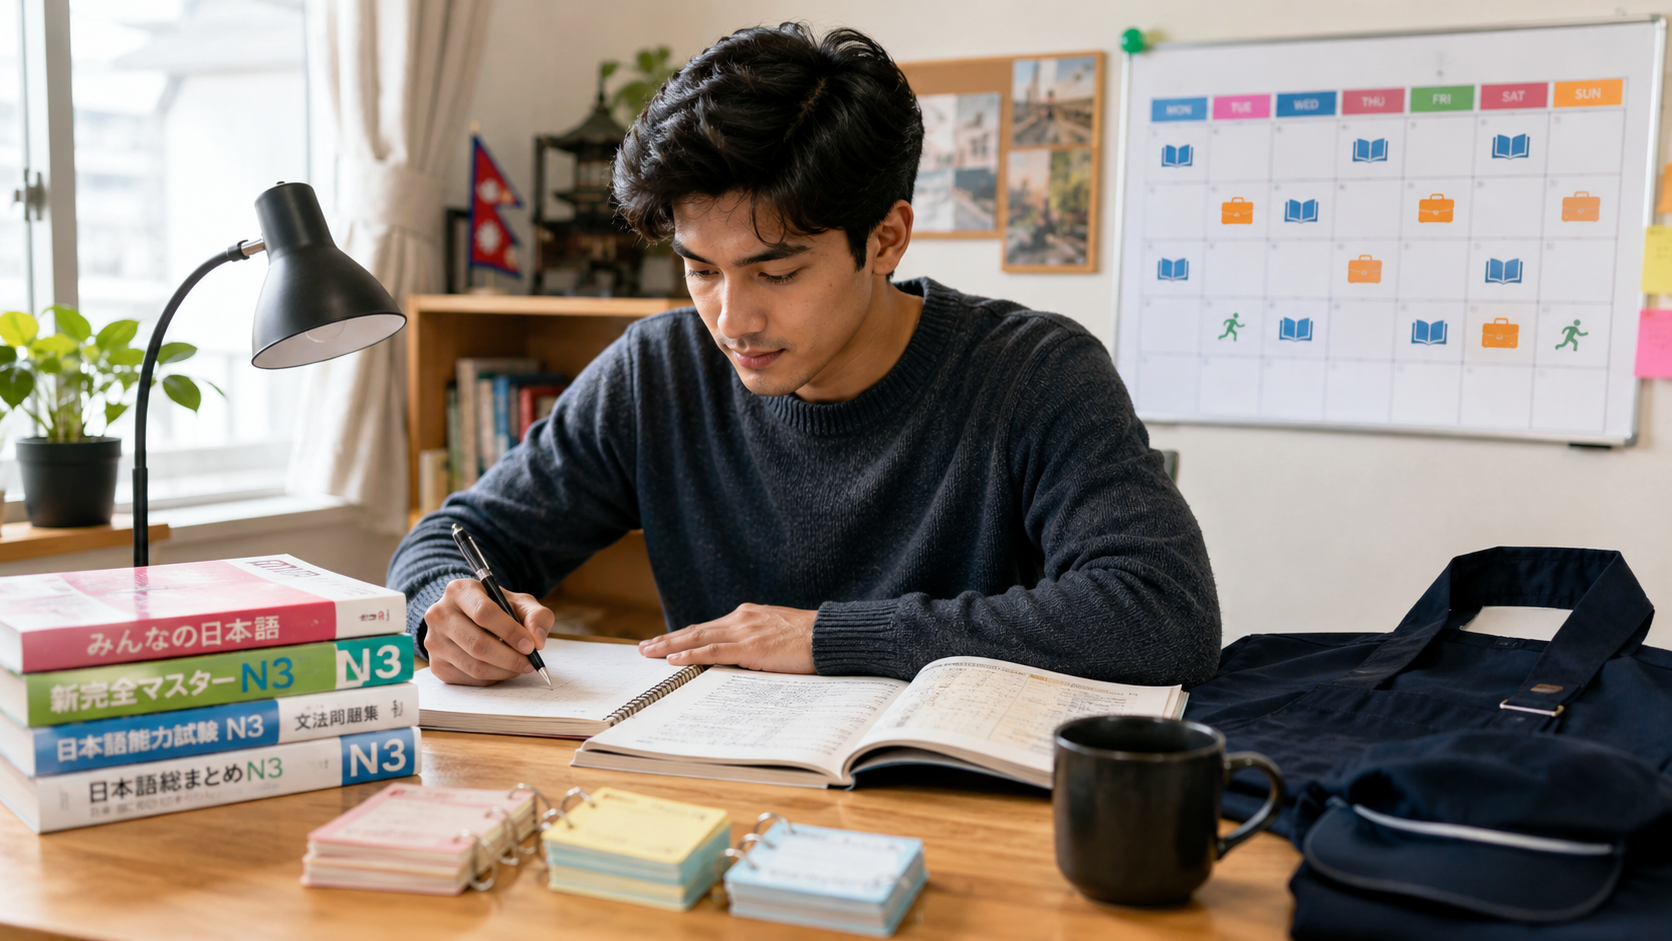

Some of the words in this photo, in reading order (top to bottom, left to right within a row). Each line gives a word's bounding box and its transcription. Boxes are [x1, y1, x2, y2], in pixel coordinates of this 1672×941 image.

[1166, 104, 1192, 116] MON
[1231, 101, 1253, 114] TUE
[1293, 98, 1319, 111] WED
[1361, 96, 1385, 107] THU
[1432, 93, 1451, 104] FRI
[1502, 90, 1525, 103] SAT
[1575, 87, 1601, 100] SUN
[87, 615, 281, 656] みんなの日本語
[50, 669, 236, 714] 新完全マスター
[241, 657, 294, 693] N3
[337, 644, 402, 689] N3
[57, 719, 219, 762] 日本語能力試験
[227, 714, 264, 740] N3
[294, 705, 378, 731] 文法問題集
[350, 738, 406, 777] N3
[90, 764, 243, 803] 日本語総まとめ
[247, 757, 283, 781] N3
